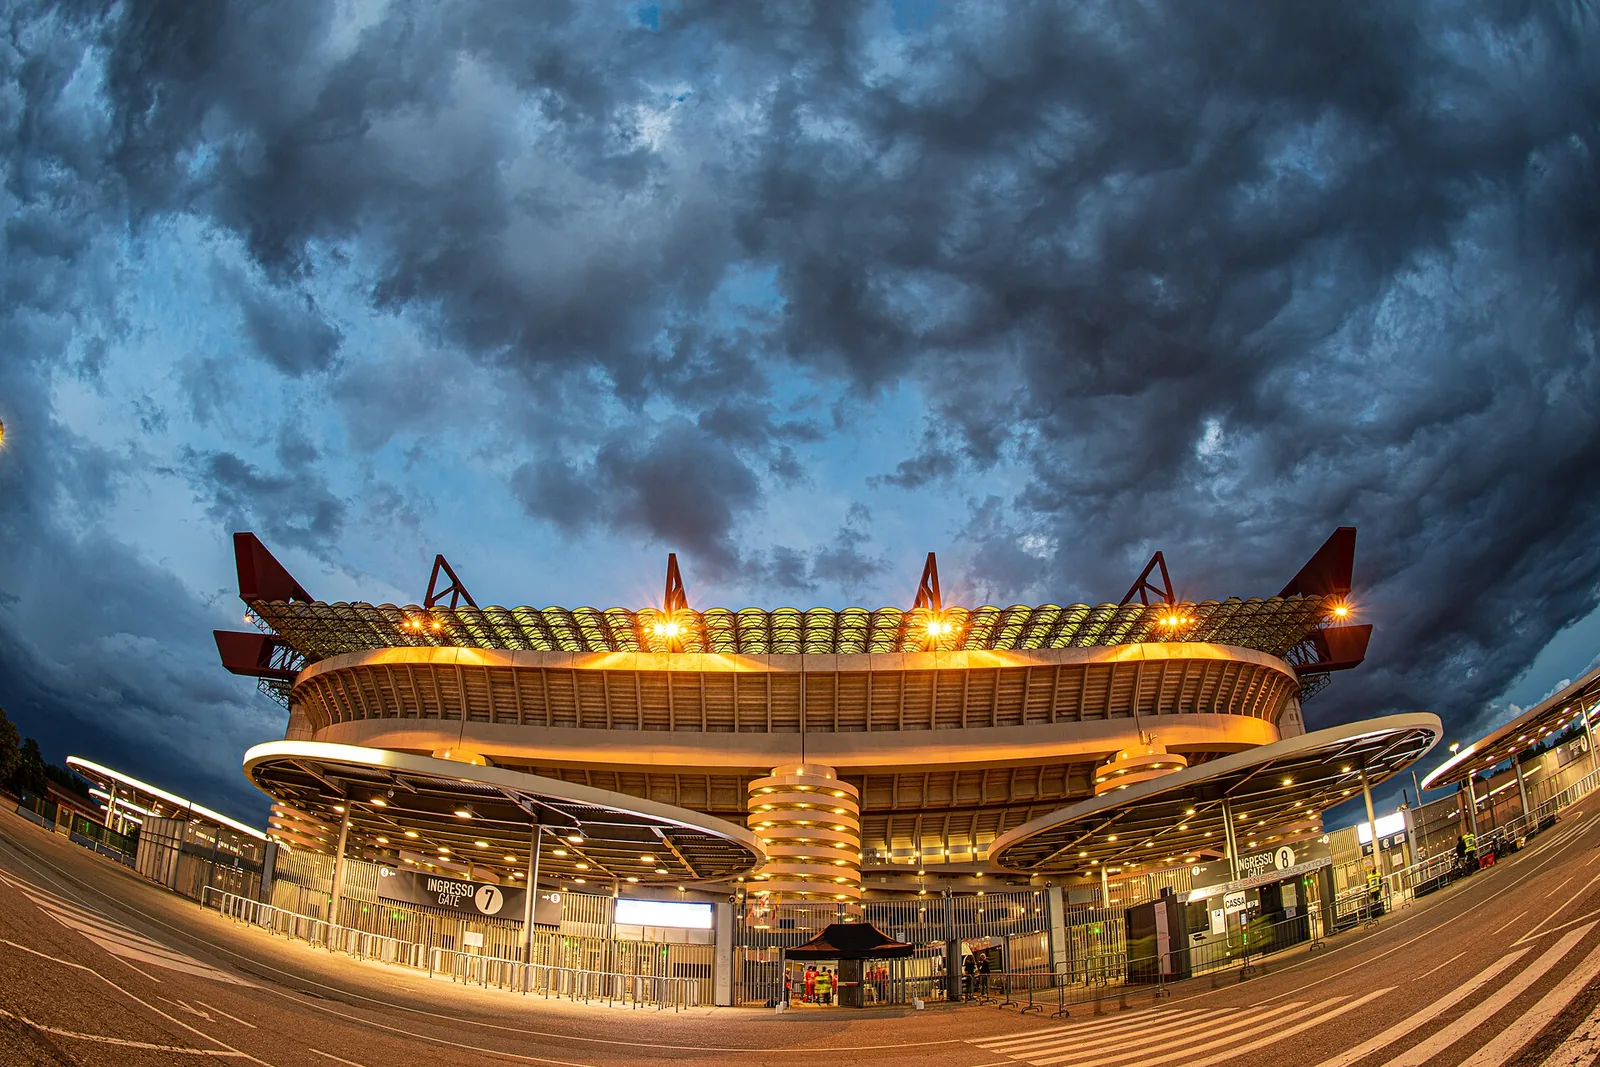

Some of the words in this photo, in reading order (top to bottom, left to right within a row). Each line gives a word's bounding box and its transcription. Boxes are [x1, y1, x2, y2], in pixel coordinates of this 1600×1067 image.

[1239, 852, 1274, 871] NGRESSO
[1281, 850, 1289, 868] 8
[1242, 877, 1260, 886] SAN
[1260, 872, 1278, 883] SIRO
[1279, 862, 1311, 877] STADIUM
[1311, 857, 1331, 868] TOUR
[427, 878, 474, 898] INGRESSO
[438, 893, 461, 907] GATE
[484, 889, 495, 910] 7
[1225, 897, 1246, 909] CASSA
